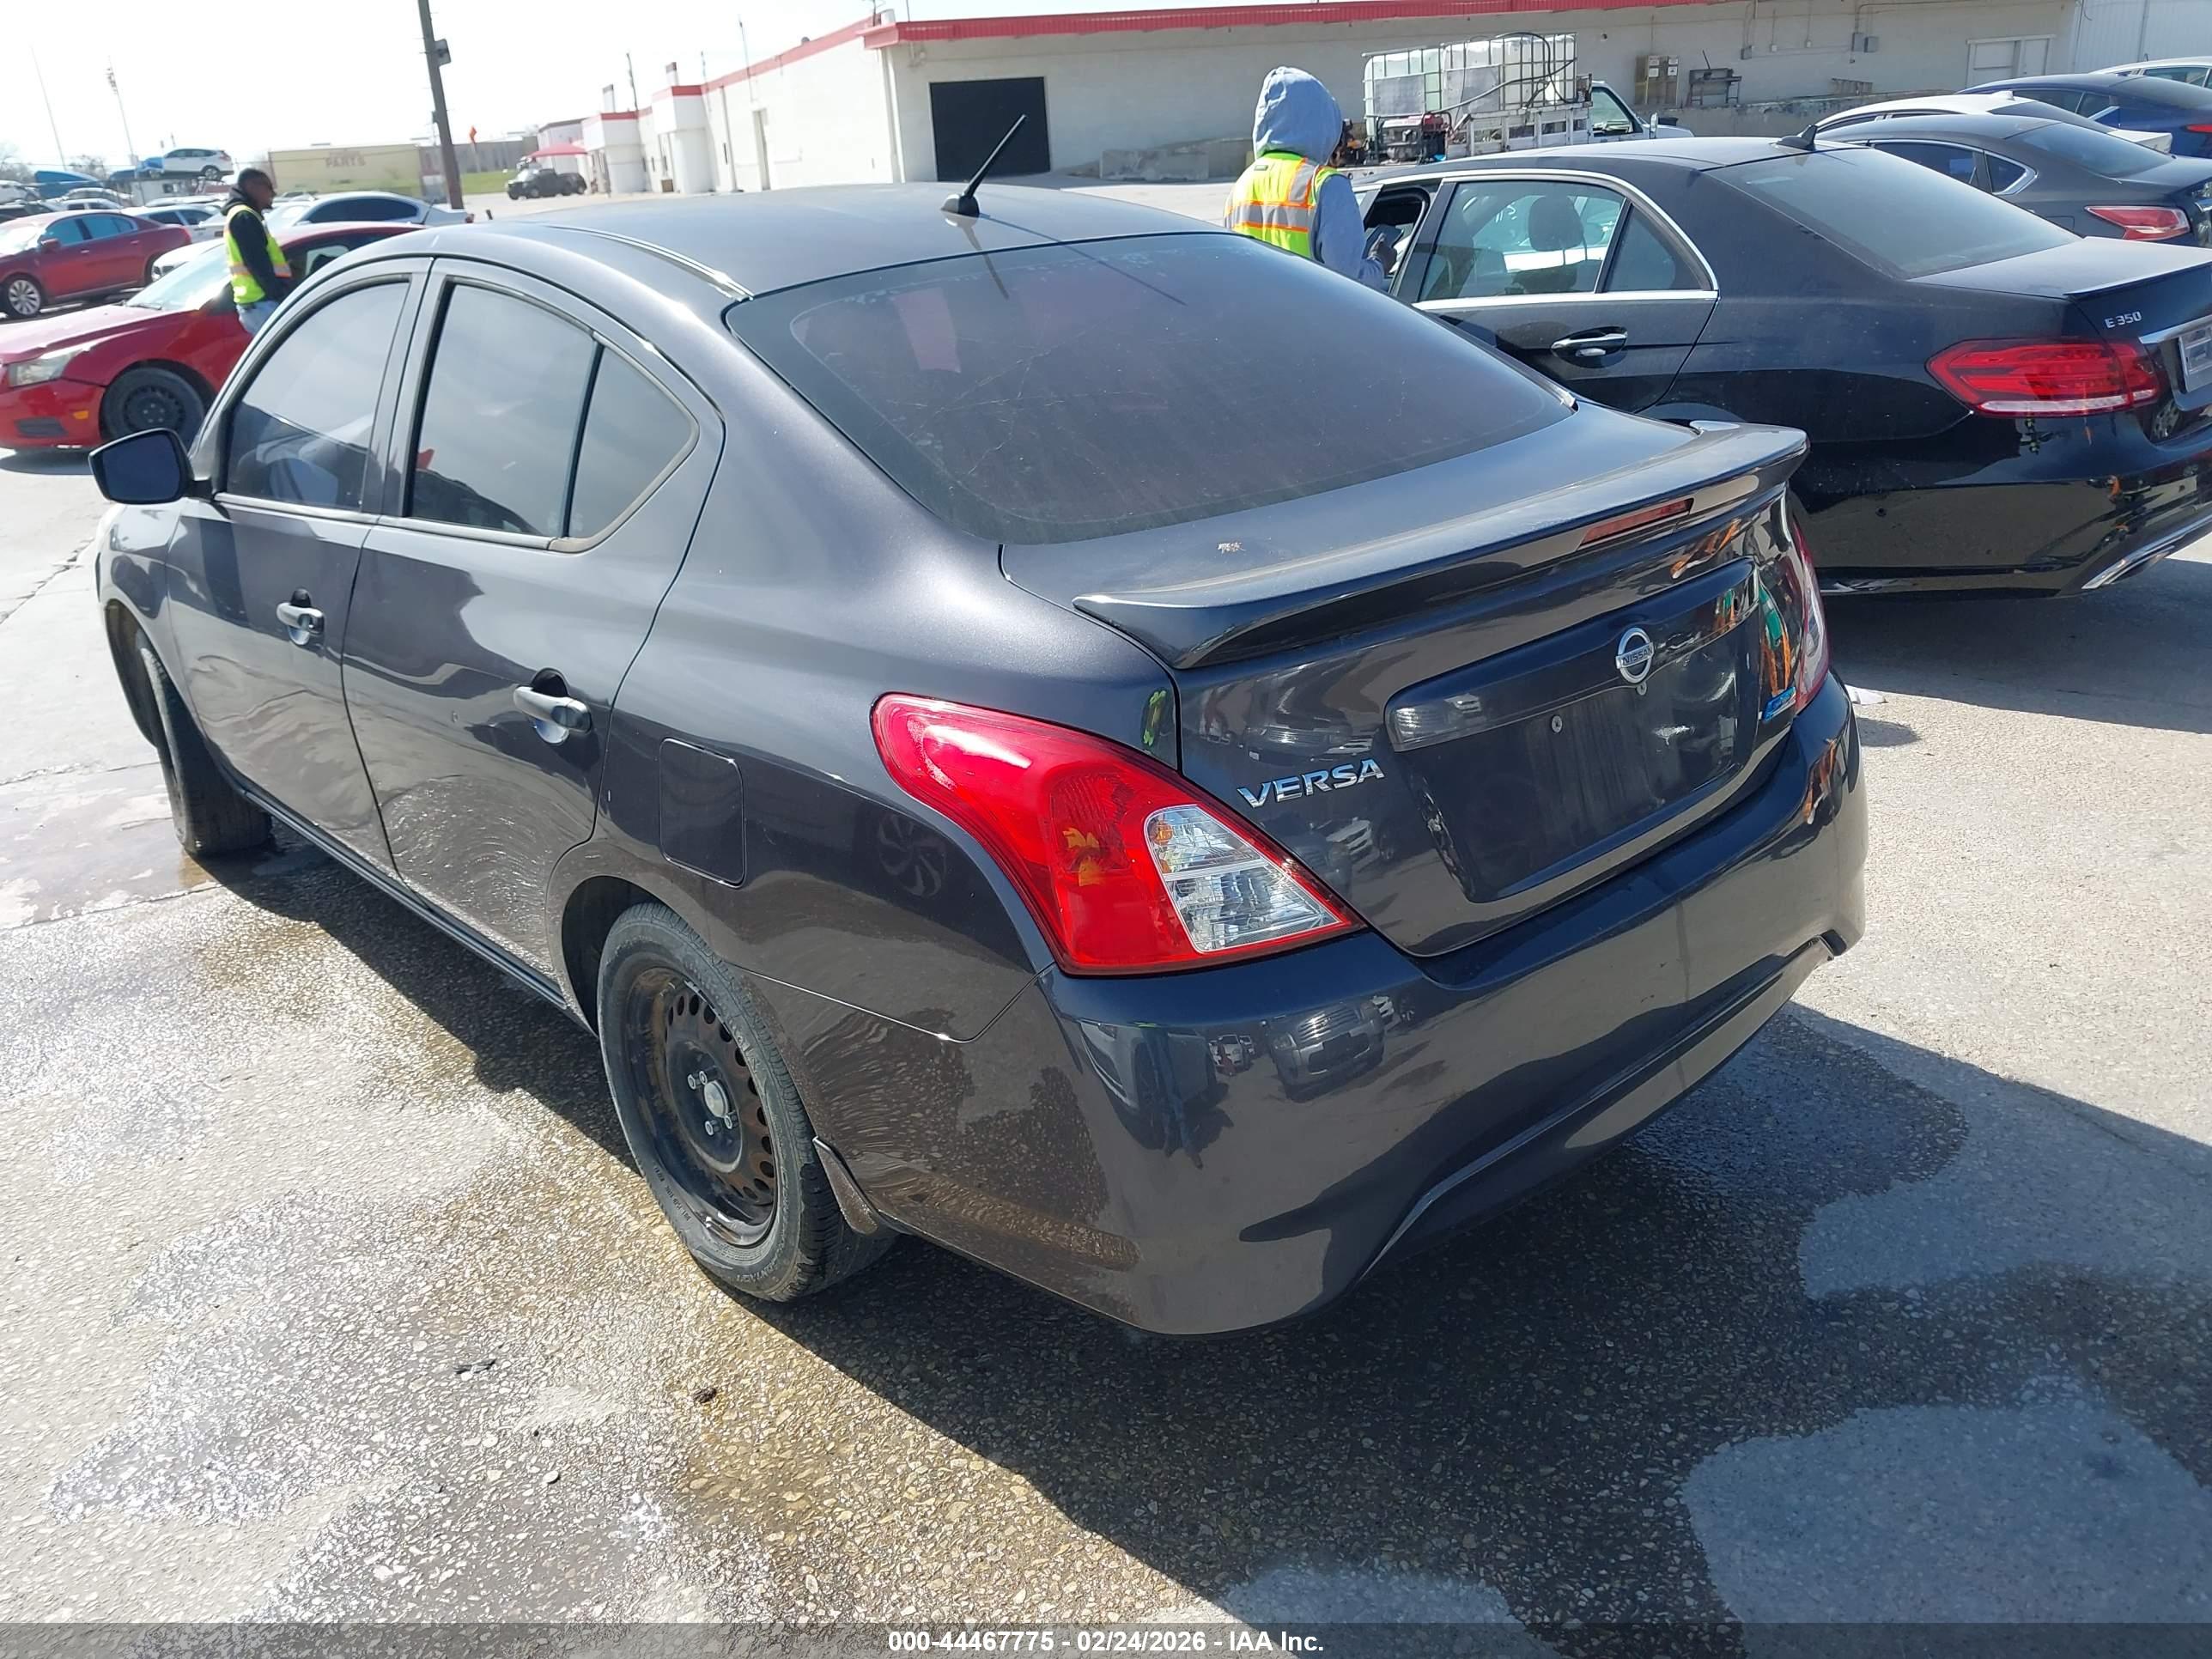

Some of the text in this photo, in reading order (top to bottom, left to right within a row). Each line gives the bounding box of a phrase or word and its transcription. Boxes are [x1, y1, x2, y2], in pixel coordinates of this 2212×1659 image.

[325, 156, 367, 167] PARTS
[2105, 311, 2142, 328] E 350
[1622, 647, 1653, 664] NISSAN
[1237, 758, 1384, 808] VERSA
